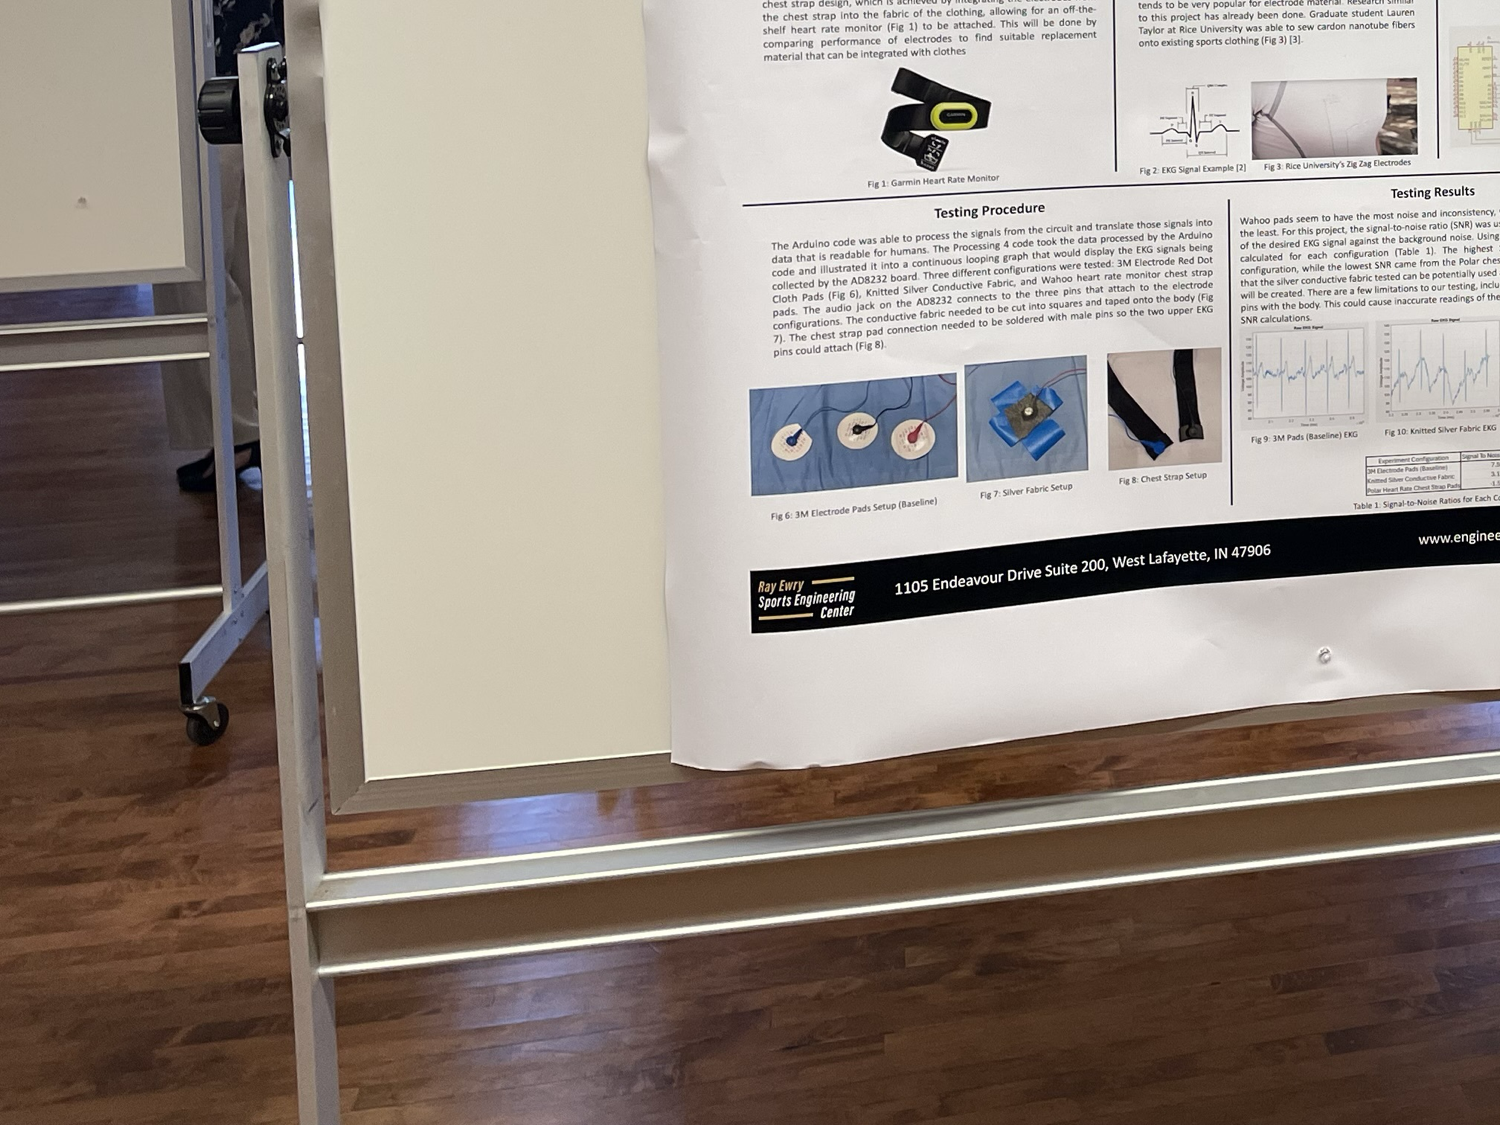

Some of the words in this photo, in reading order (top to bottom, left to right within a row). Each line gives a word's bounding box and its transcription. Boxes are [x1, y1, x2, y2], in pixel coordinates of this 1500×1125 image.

[1139, 167, 1151, 176] Fig
[1161, 166, 1176, 174] EKG
[1178, 165, 1200, 174] Signal
[1202, 164, 1234, 173] Example
[1235, 163, 1246, 173] [2]
[1263, 163, 1275, 172] Fig
[1285, 162, 1301, 170] Rice
[1346, 160, 1357, 169] Zig
[1358, 159, 1372, 168] Zag
[1373, 158, 1411, 167] Electrodes
[867, 180, 880, 189] Fig
[890, 178, 921, 187] Garmin
[922, 177, 945, 185] Heart
[967, 174, 1000, 182] Monitor
[1390, 187, 1431, 200] Testing
[1434, 185, 1475, 197] Results
[933, 206, 978, 219] Testing
[982, 202, 1045, 216] Procedure
[1251, 436, 1262, 444] Fig
[1272, 434, 1285, 442] 3M
[1286, 433, 1304, 441] Pads
[1305, 431, 1342, 441] (Baseline)
[1343, 430, 1358, 438] EKG
[1384, 428, 1395, 437] Fig
[1410, 426, 1436, 434] Knitted
[1118, 477, 1130, 486] Fig
[1140, 474, 1162, 483] Chest
[1163, 473, 1184, 481] Strap
[1185, 472, 1207, 480] Setup
[980, 491, 992, 500] Fig
[1002, 488, 1024, 497] Silver
[1025, 485, 1048, 494] Fabric
[1050, 483, 1073, 492] Setup
[770, 512, 783, 521] Fig
[795, 509, 809, 519] 3M
[811, 506, 850, 517] Electrode
[851, 504, 871, 513] Pads
[872, 503, 897, 511] Setup
[898, 496, 938, 510] (Baseline)
[1353, 502, 1372, 510] Table
[1382, 498, 1437, 509] Signal-to-Noise
[1462, 495, 1473, 503] for
[1474, 494, 1491, 502] Each
[894, 579, 929, 595] 1105
[932, 572, 1004, 591] Endeavour
[1007, 567, 1042, 581] Drive
[1044, 562, 1078, 577] Suite
[1081, 558, 1109, 573] 200,
[1112, 554, 1145, 568] West
[1148, 550, 1210, 565] Lafayette,
[1214, 547, 1228, 560] IN
[1230, 543, 1271, 558] 47906
[757, 580, 777, 595] Ray
[778, 579, 805, 593] Ewry
[757, 590, 792, 611] Sports
[793, 588, 856, 608] Engineering
[820, 604, 855, 619] Center
